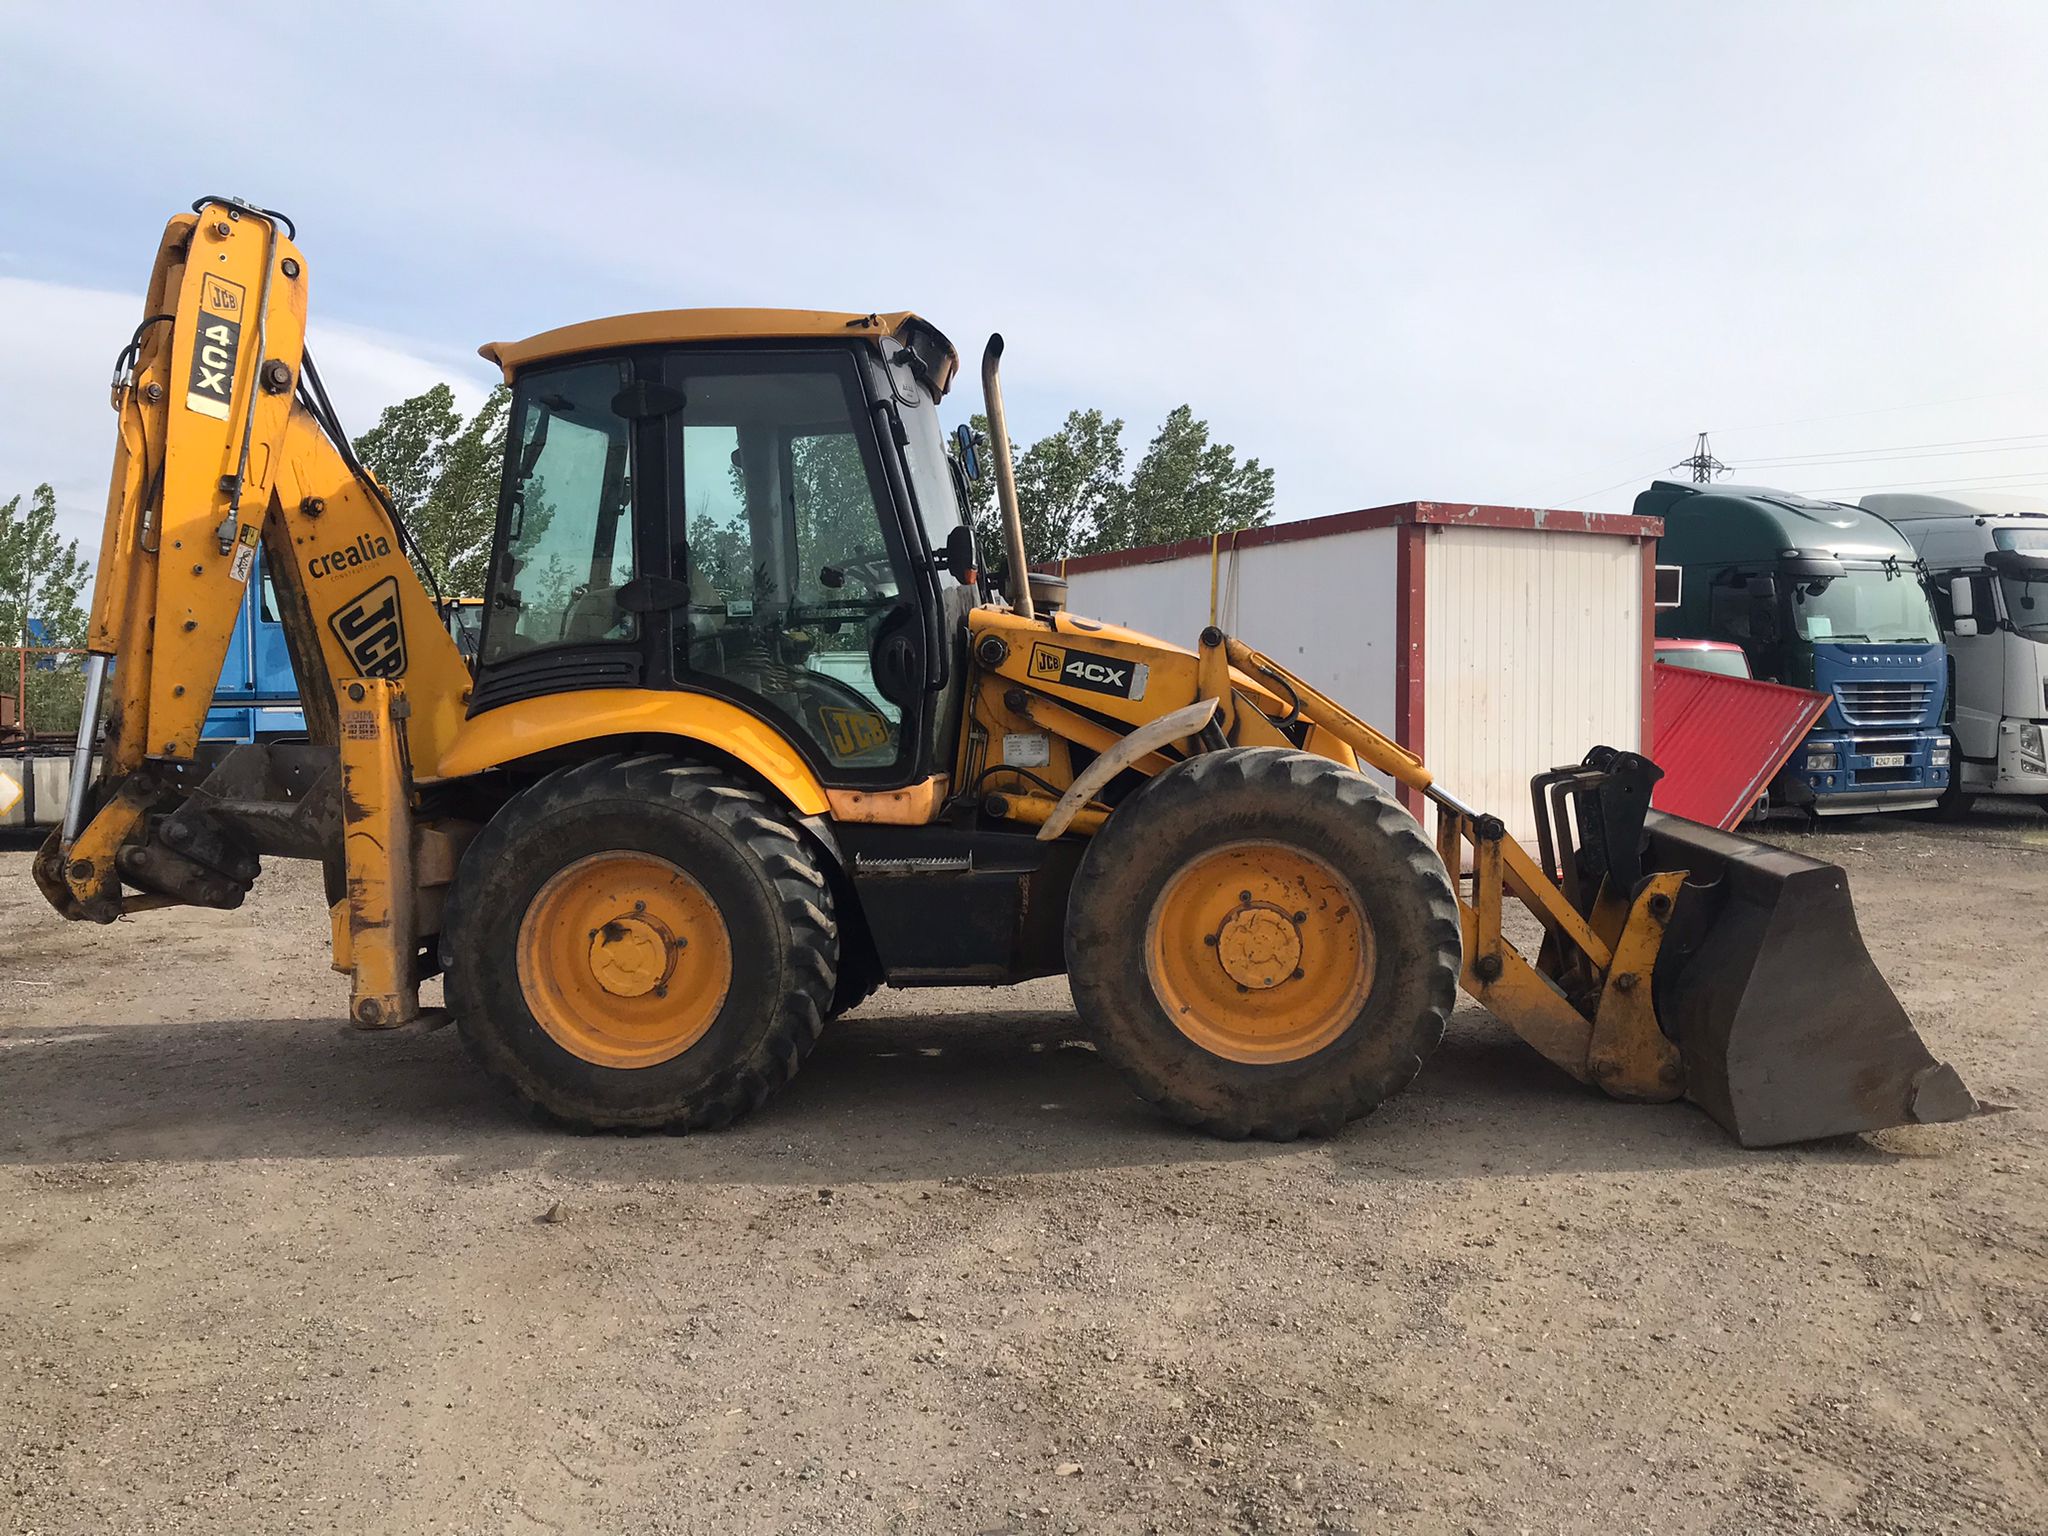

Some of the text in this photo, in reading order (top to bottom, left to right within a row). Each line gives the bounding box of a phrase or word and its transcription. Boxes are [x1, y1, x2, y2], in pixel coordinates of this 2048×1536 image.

[212, 286, 236, 309] JCB
[197, 324, 231, 395] 4CX
[308, 533, 392, 579] crealia
[339, 595, 402, 678] JCB
[1039, 652, 1060, 671] JCB
[1065, 661, 1127, 687] 4CX
[1850, 656, 1923, 665] STRALIS
[832, 712, 887, 754] JCB
